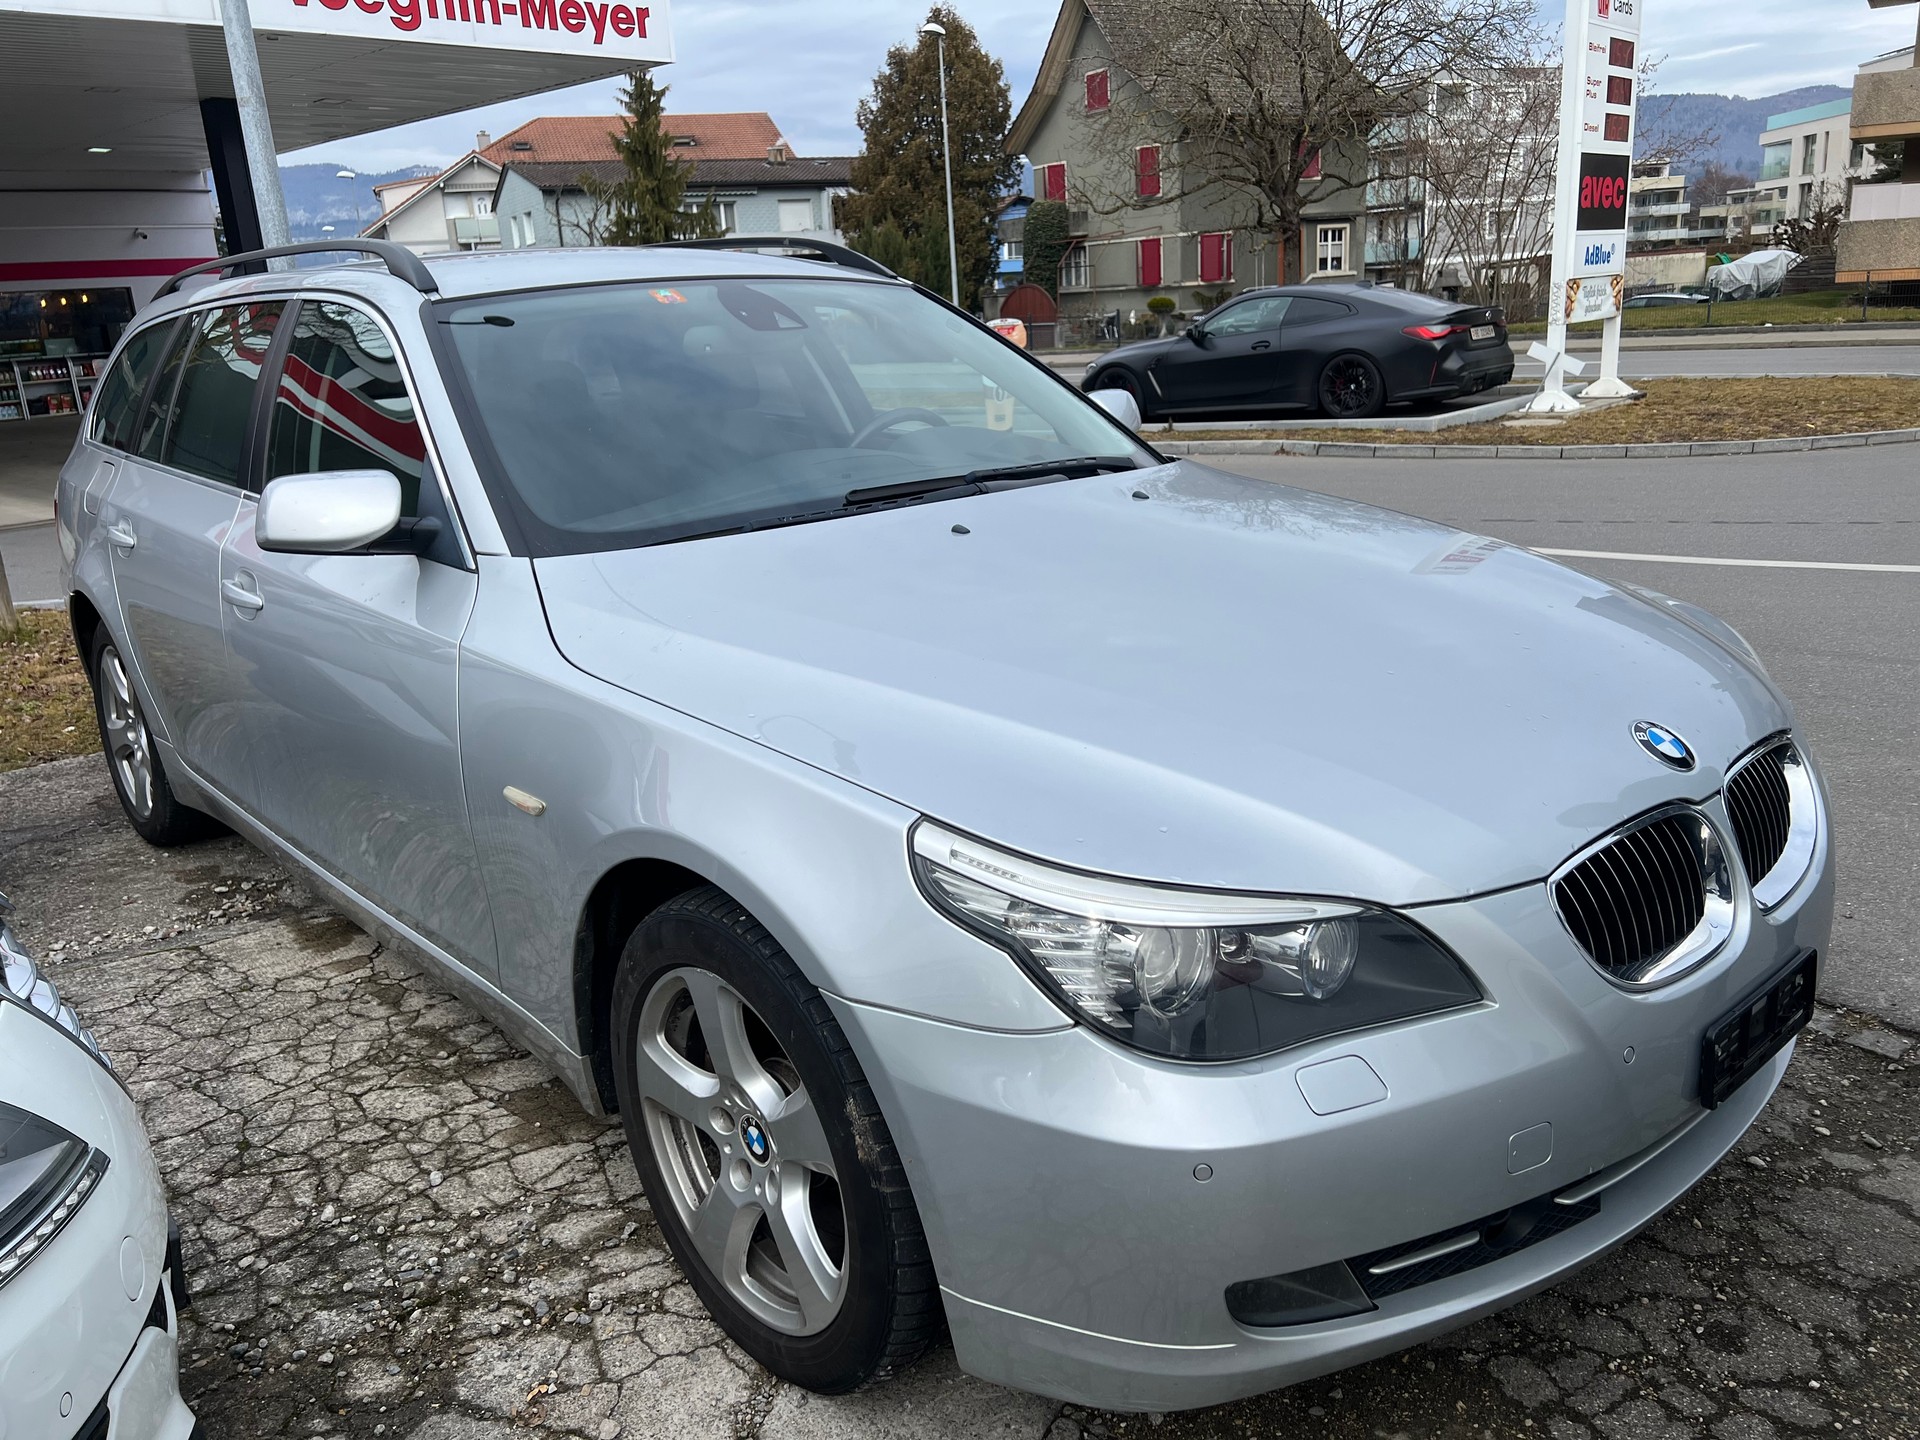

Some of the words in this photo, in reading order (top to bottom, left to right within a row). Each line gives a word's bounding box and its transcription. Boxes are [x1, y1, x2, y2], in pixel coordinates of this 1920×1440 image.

[1613, 0, 1633, 16] Cards
[292, 0, 650, 45] gn-Meyer
[1587, 76, 1602, 87] Super
[1586, 89, 1597, 99] Plus
[1584, 122, 1599, 133] Diesel
[1580, 175, 1625, 209] avec
